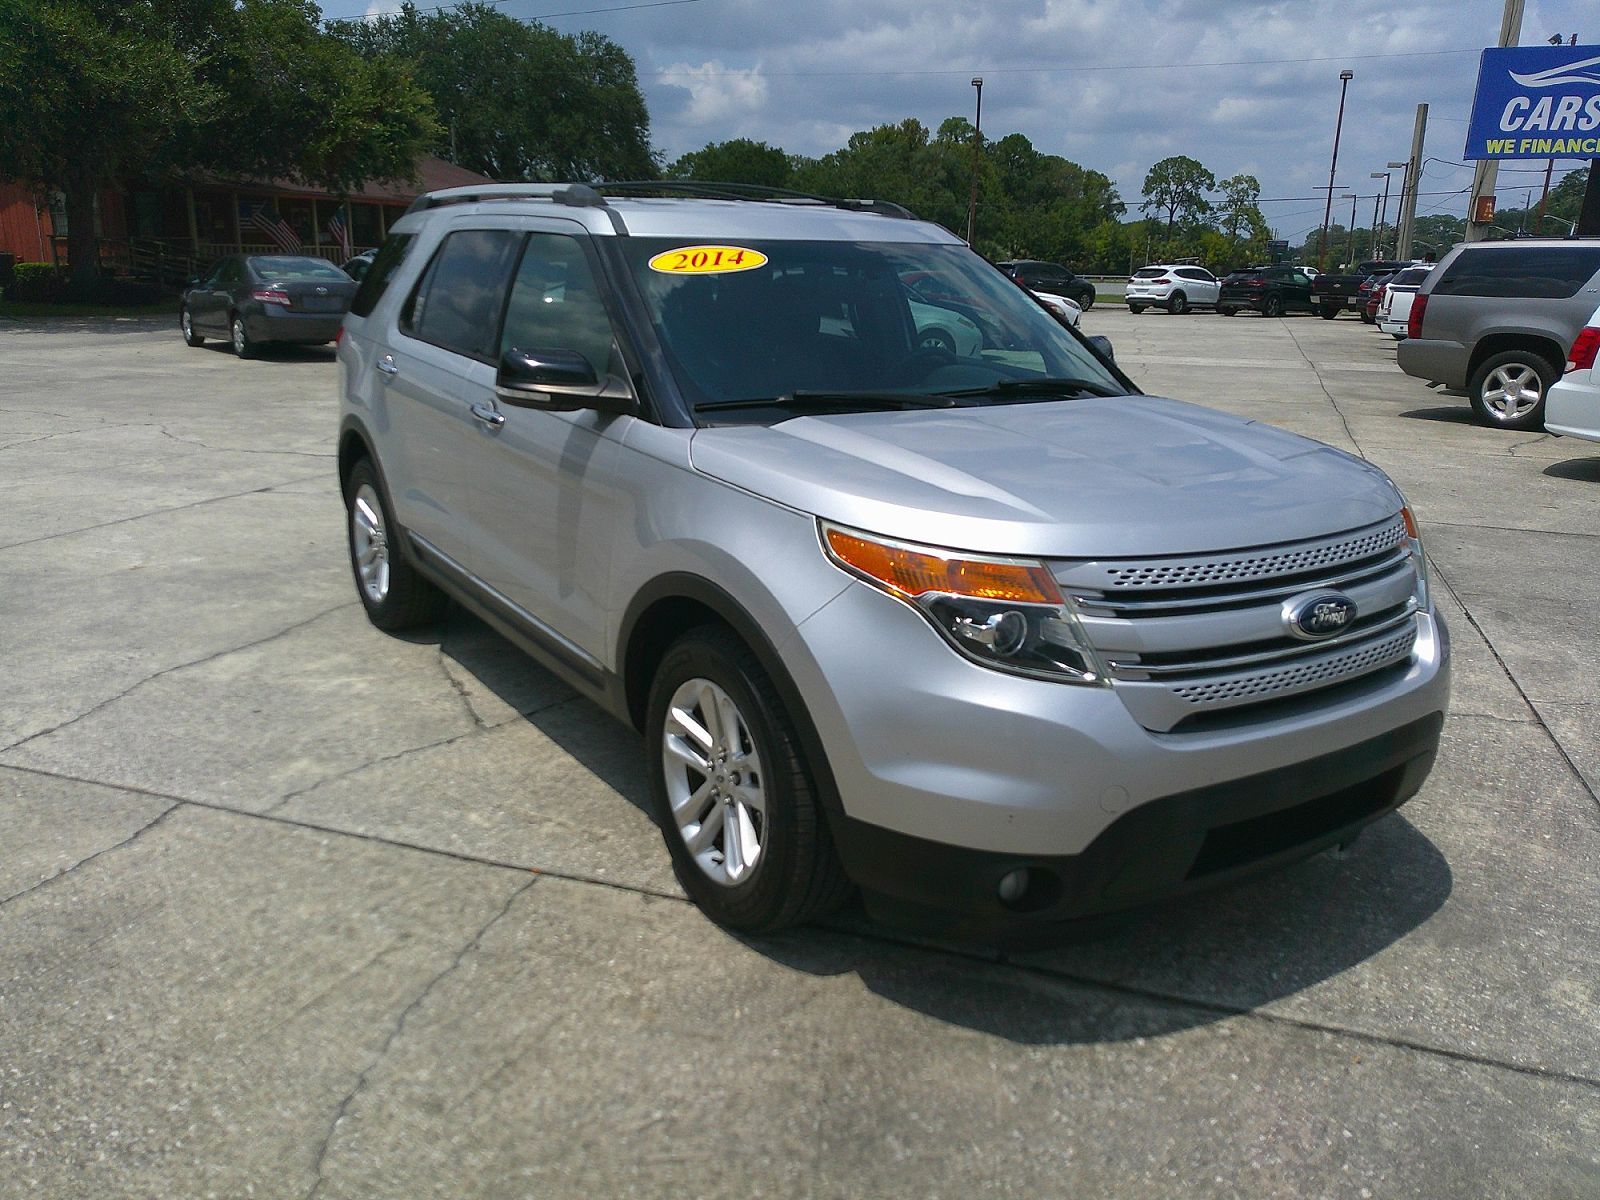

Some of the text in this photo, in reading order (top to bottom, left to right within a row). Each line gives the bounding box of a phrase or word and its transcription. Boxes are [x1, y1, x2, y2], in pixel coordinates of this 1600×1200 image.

[1500, 95, 1600, 131] CARS
[1486, 139, 1516, 153] WE
[672, 250, 744, 269] 2014
[1311, 602, 1347, 625] Ford
